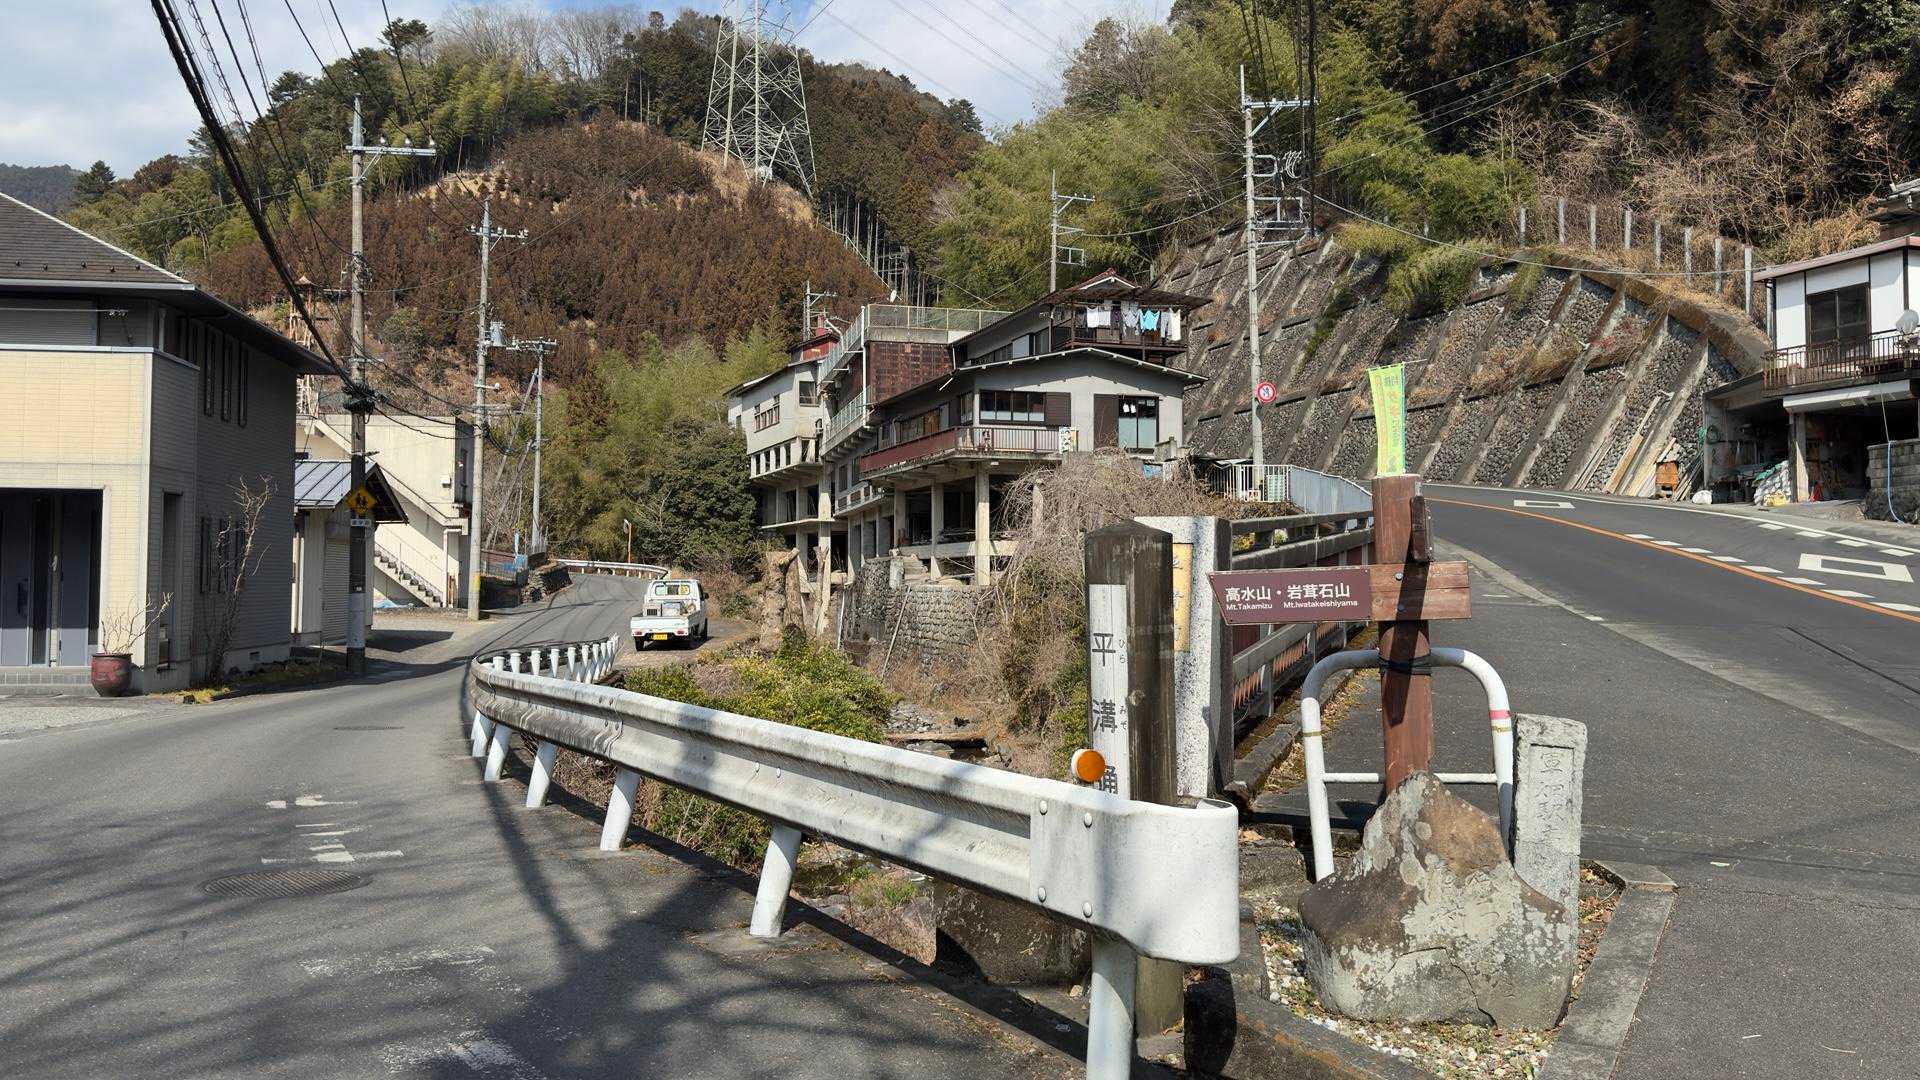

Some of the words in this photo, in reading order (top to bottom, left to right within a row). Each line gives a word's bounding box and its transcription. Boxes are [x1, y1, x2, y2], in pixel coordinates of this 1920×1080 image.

[1225, 582, 1350, 603] 高水山・岩茸石山
[1226, 602, 1273, 611] Mt.Takamizu
